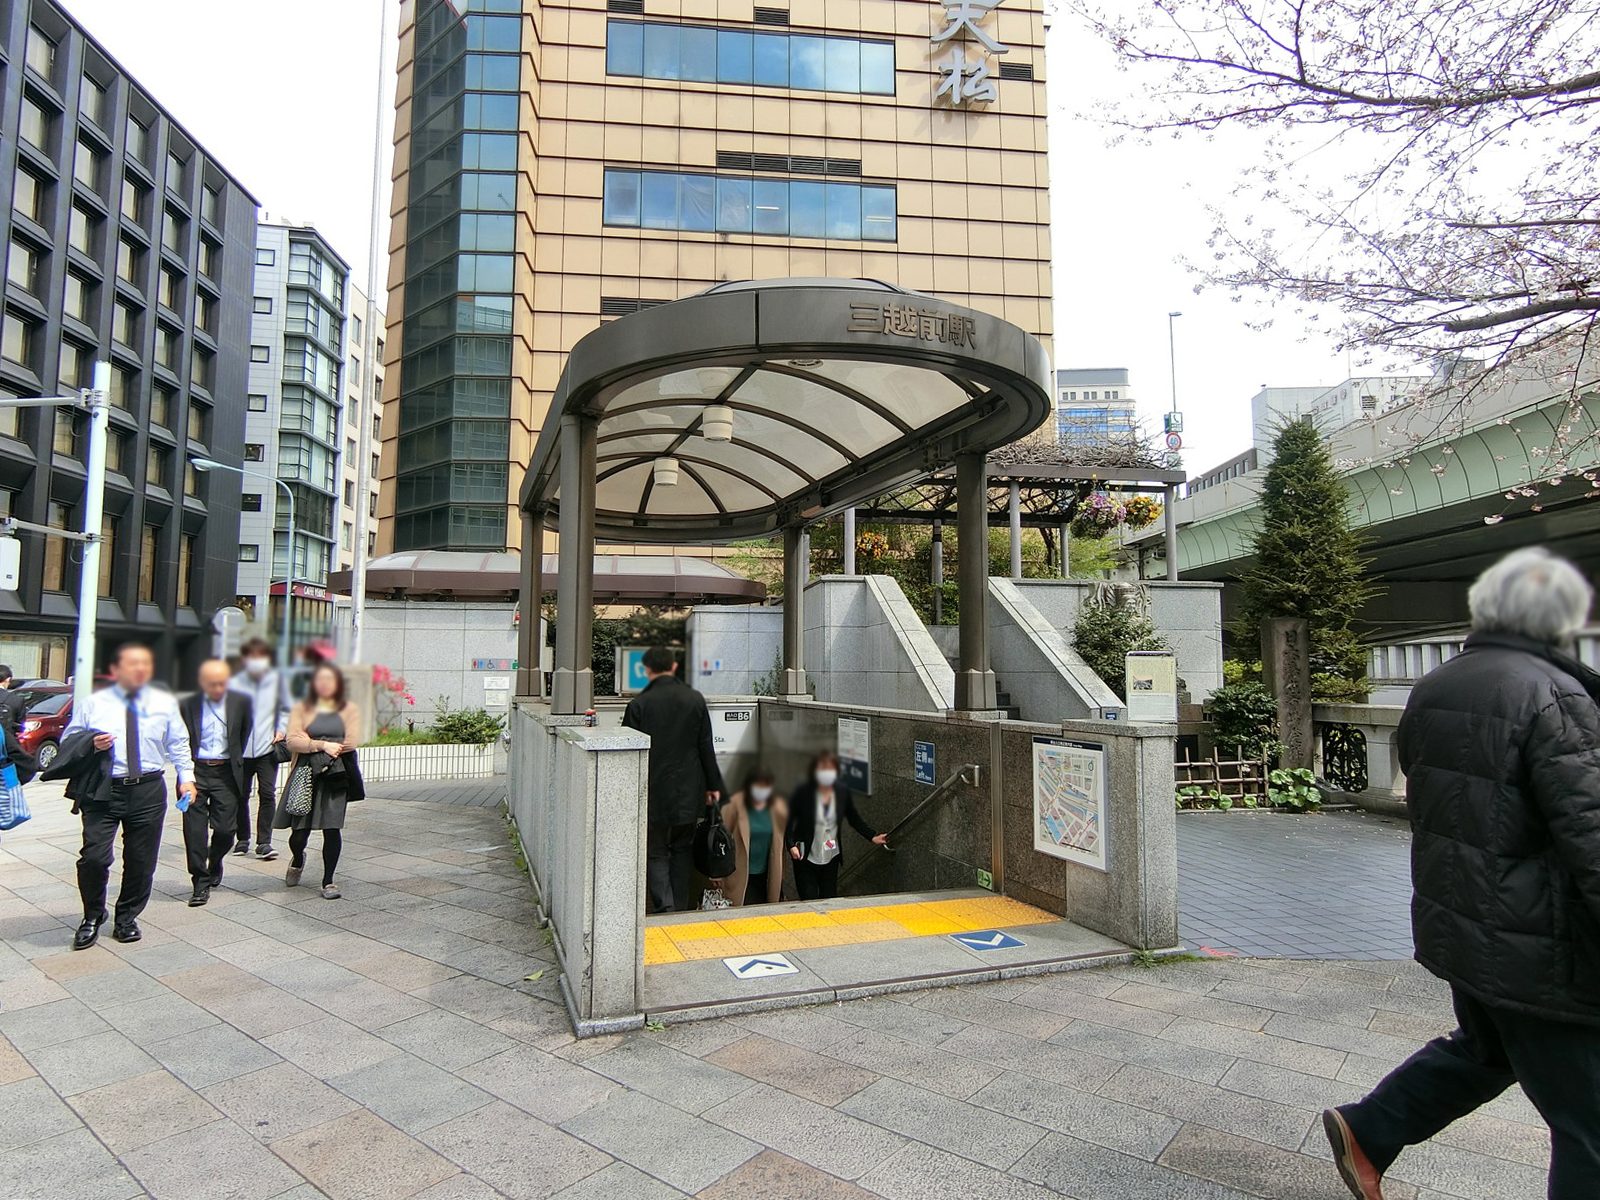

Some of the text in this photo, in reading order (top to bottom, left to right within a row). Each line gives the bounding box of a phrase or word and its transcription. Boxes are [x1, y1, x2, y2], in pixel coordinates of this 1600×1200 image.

[847, 302, 976, 349] 三越前駅
[737, 712, 749, 721] B6
